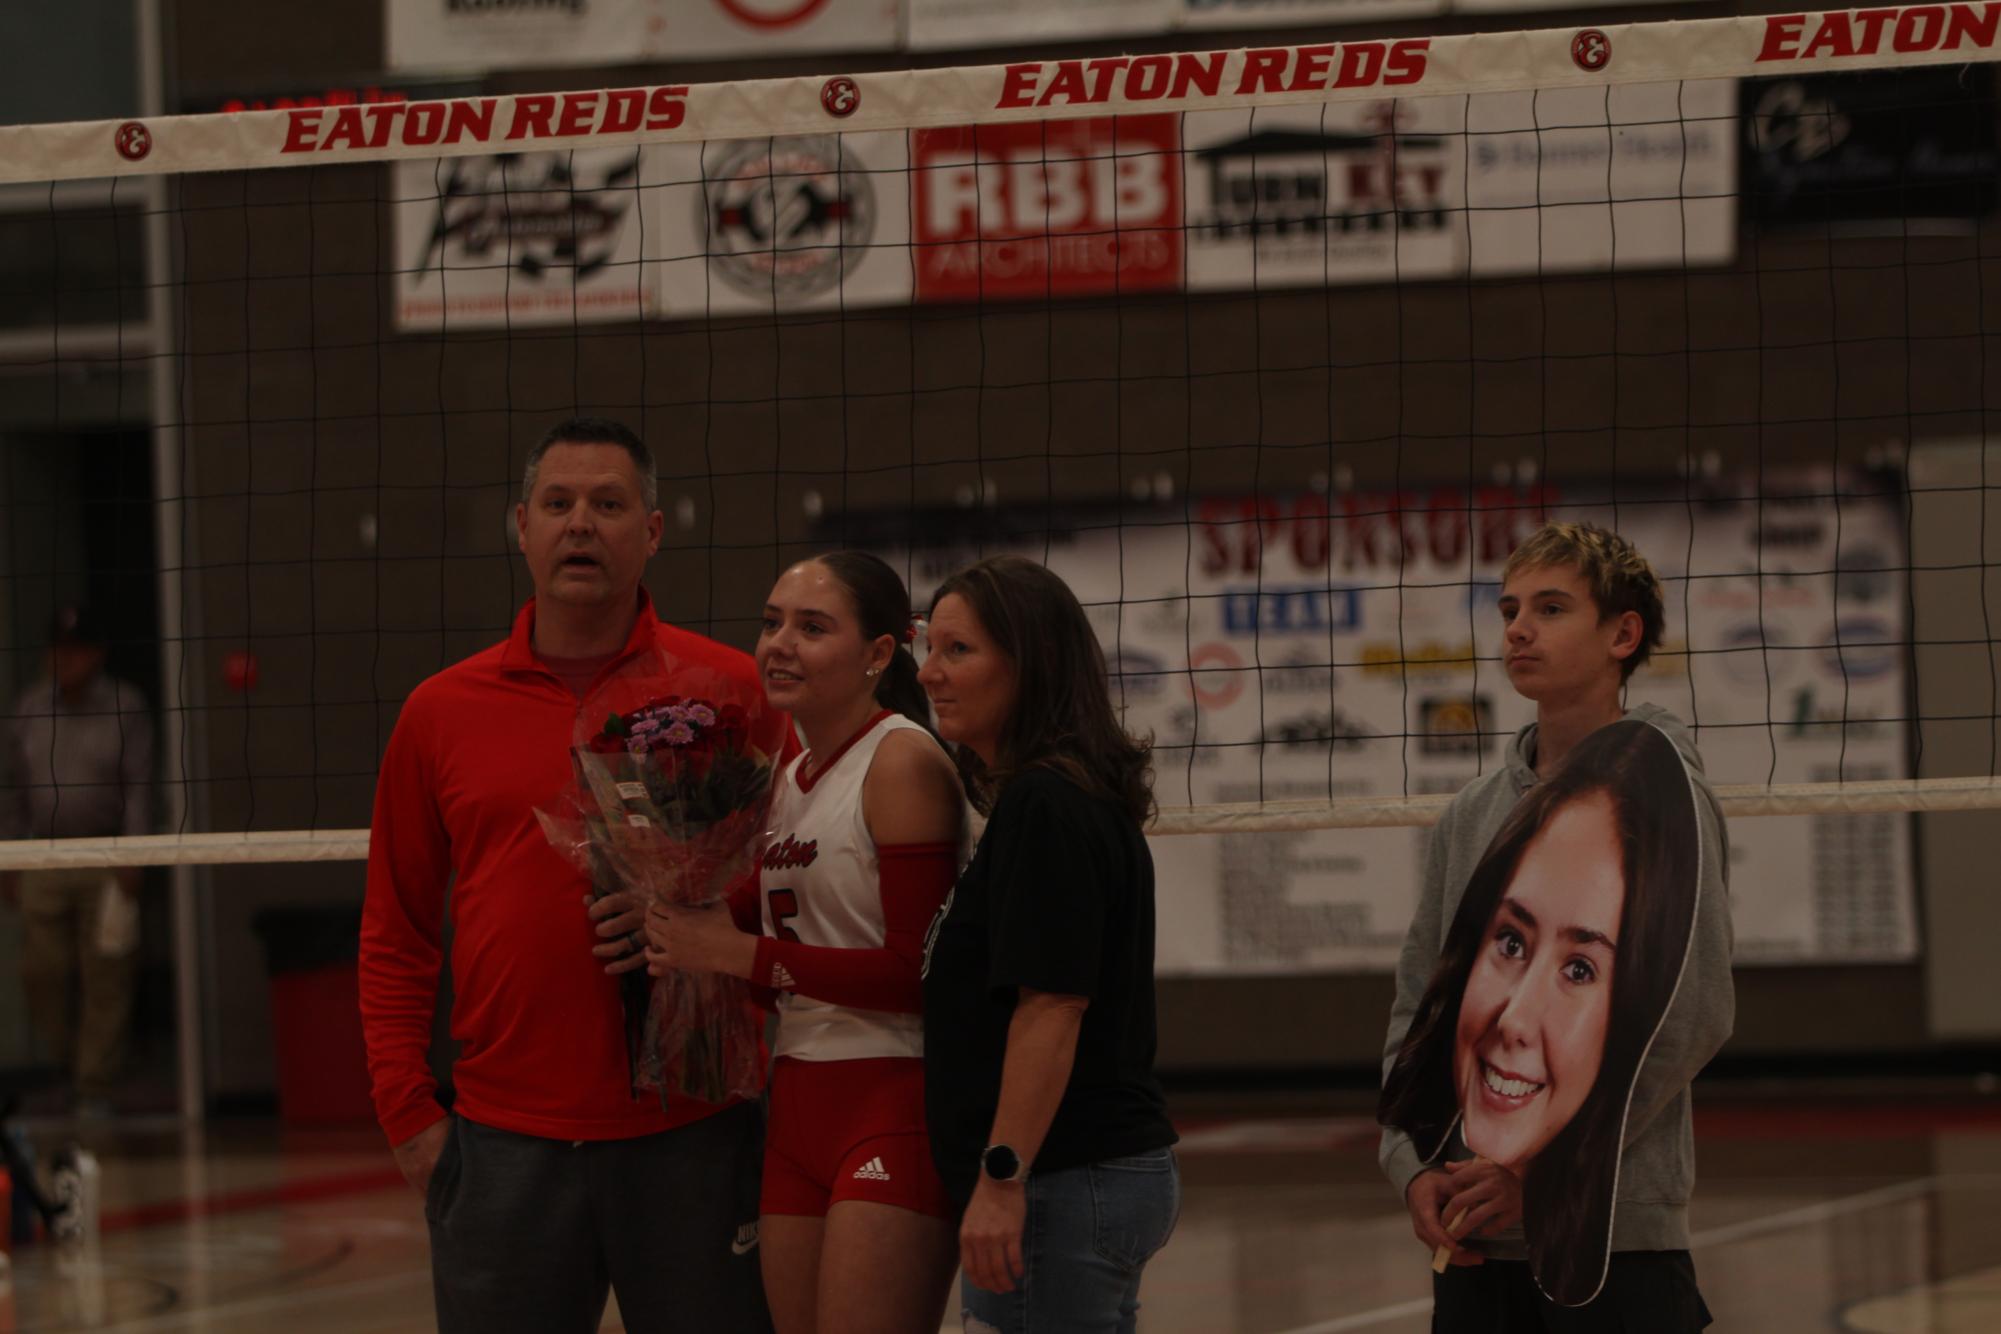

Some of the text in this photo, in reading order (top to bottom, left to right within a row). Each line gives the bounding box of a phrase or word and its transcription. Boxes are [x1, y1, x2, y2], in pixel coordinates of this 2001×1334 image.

[1755, 3, 2001, 62] EATON
[995, 40, 1430, 109] EATON REDS
[280, 87, 689, 153] EATON REDS
[924, 141, 1170, 238] RBB
[763, 833, 818, 871] aton
[852, 1170, 891, 1182] adidas
[737, 1221, 760, 1243] NIK
